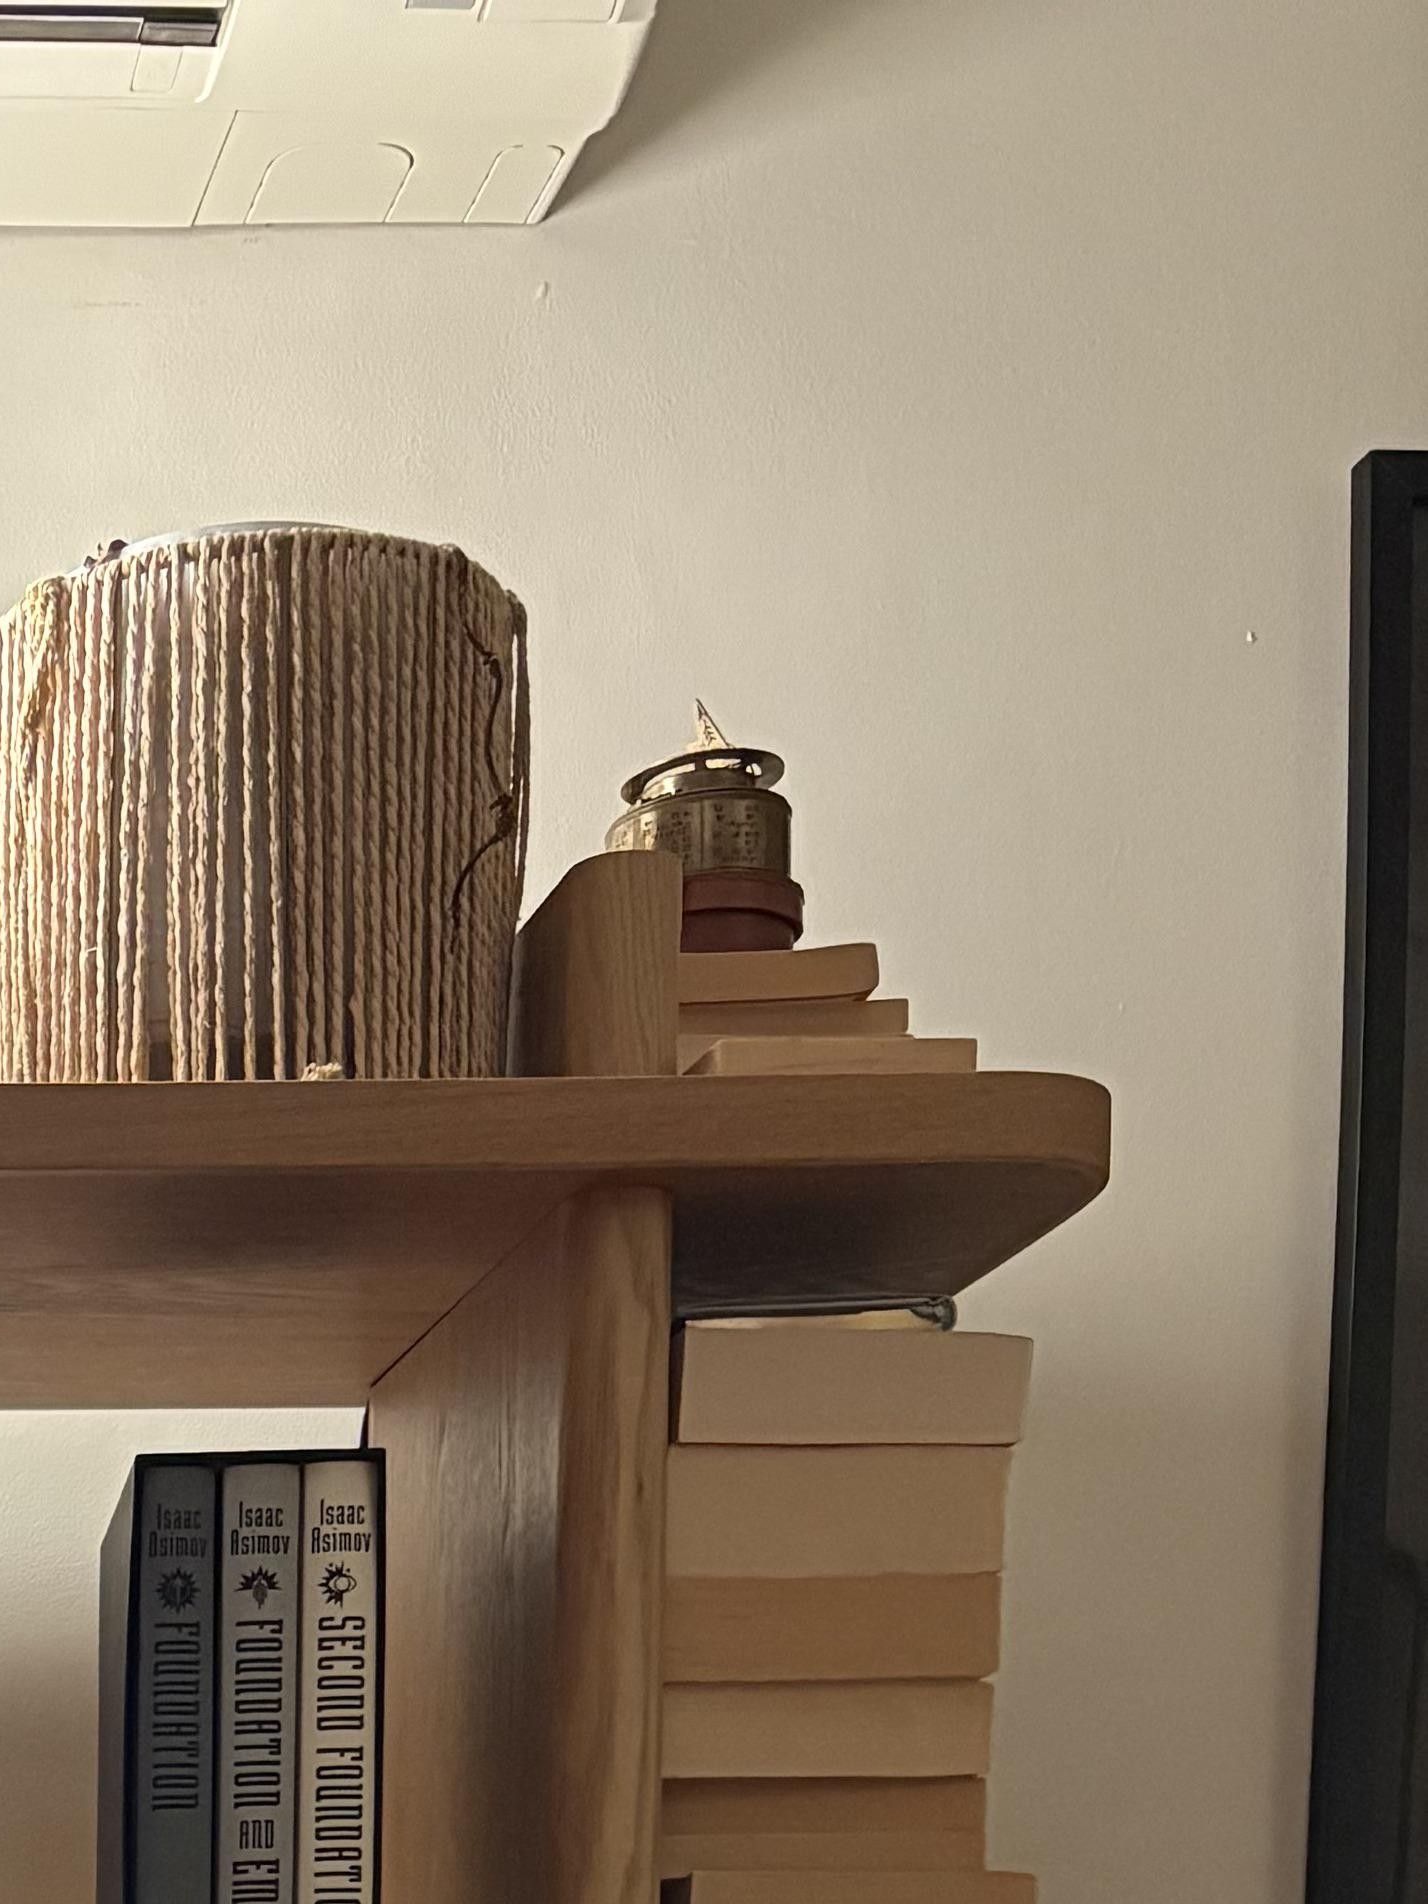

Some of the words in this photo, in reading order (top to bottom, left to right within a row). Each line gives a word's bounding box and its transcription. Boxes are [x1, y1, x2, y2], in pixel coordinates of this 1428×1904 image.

[234, 1619, 283, 1808] FOUNDATION
[316, 1615, 365, 1732] SECOND
[239, 1819, 274, 1850] AND
